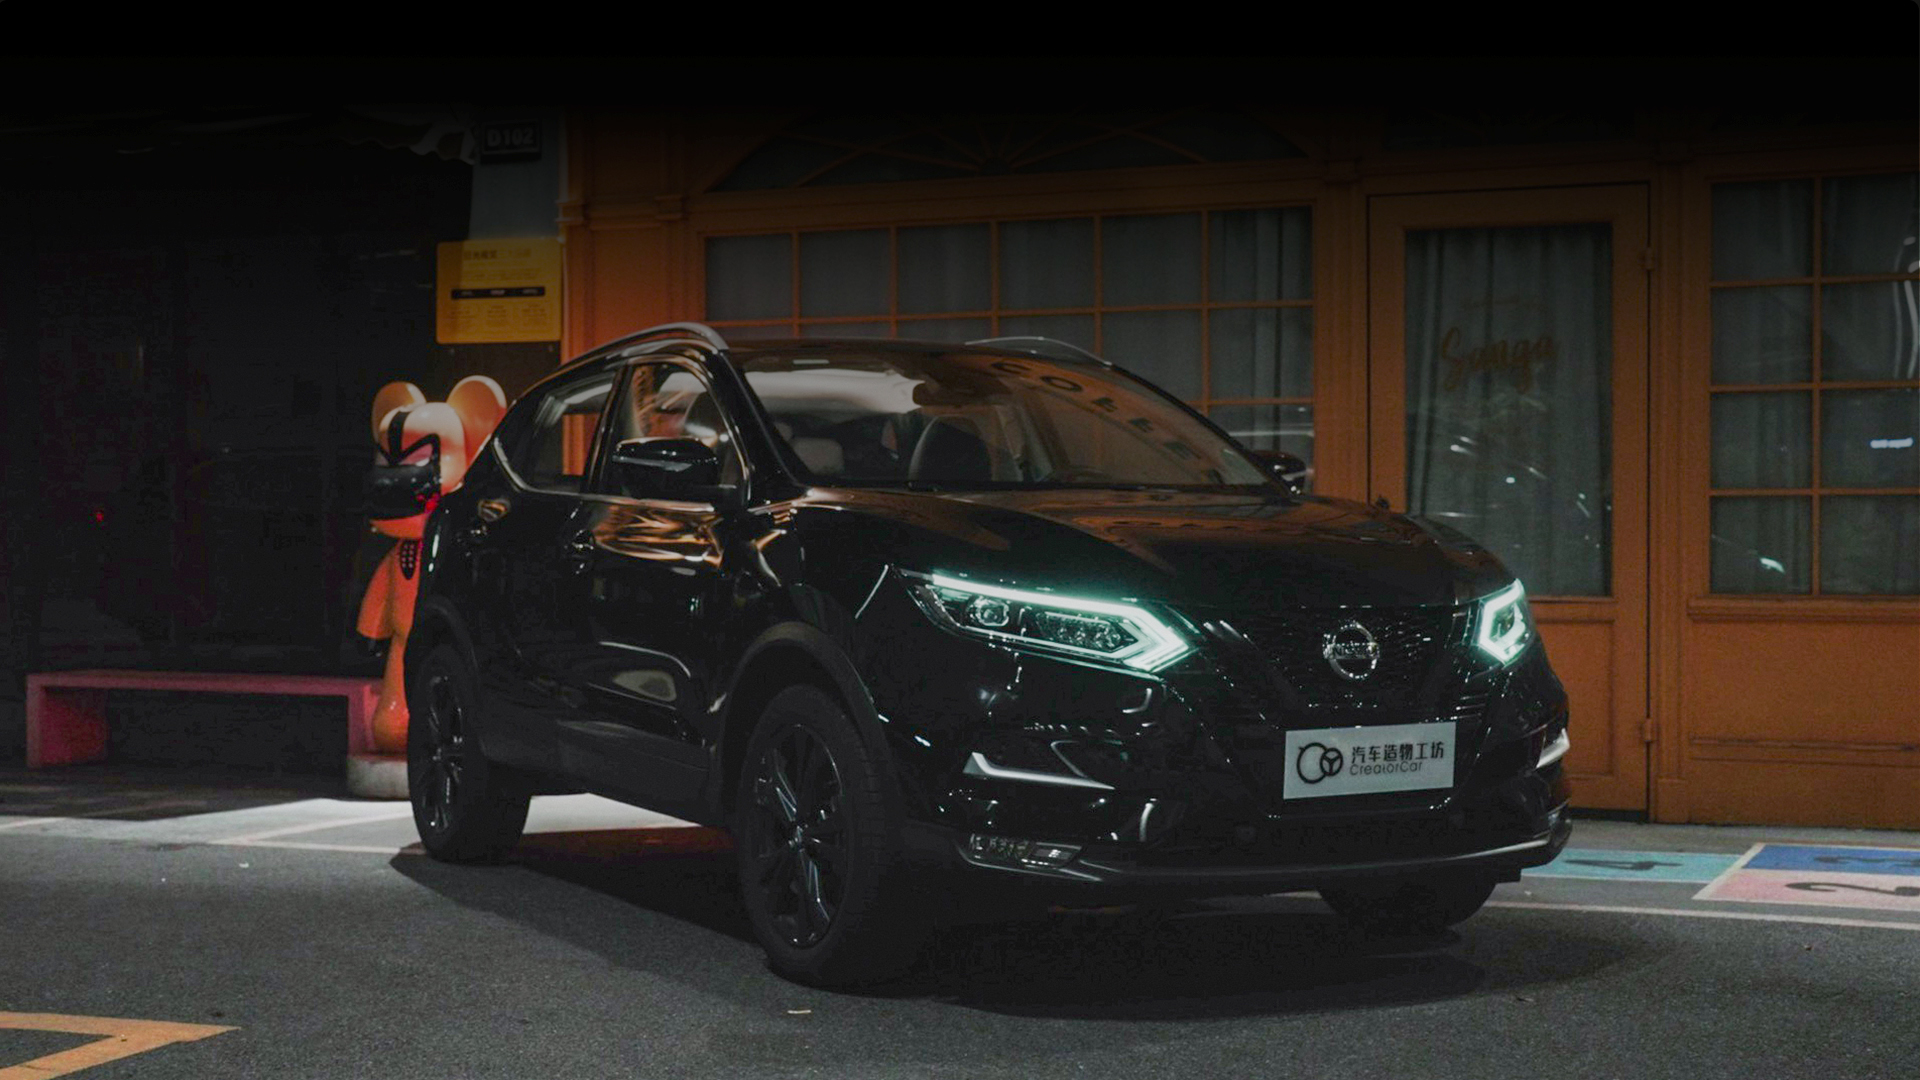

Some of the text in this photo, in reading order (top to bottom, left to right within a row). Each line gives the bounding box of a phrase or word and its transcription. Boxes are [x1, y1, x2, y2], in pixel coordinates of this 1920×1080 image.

[486, 127, 535, 147] D102
[1351, 741, 1445, 764] 汽车造物工坊
[1350, 761, 1423, 776] CreatorCar
